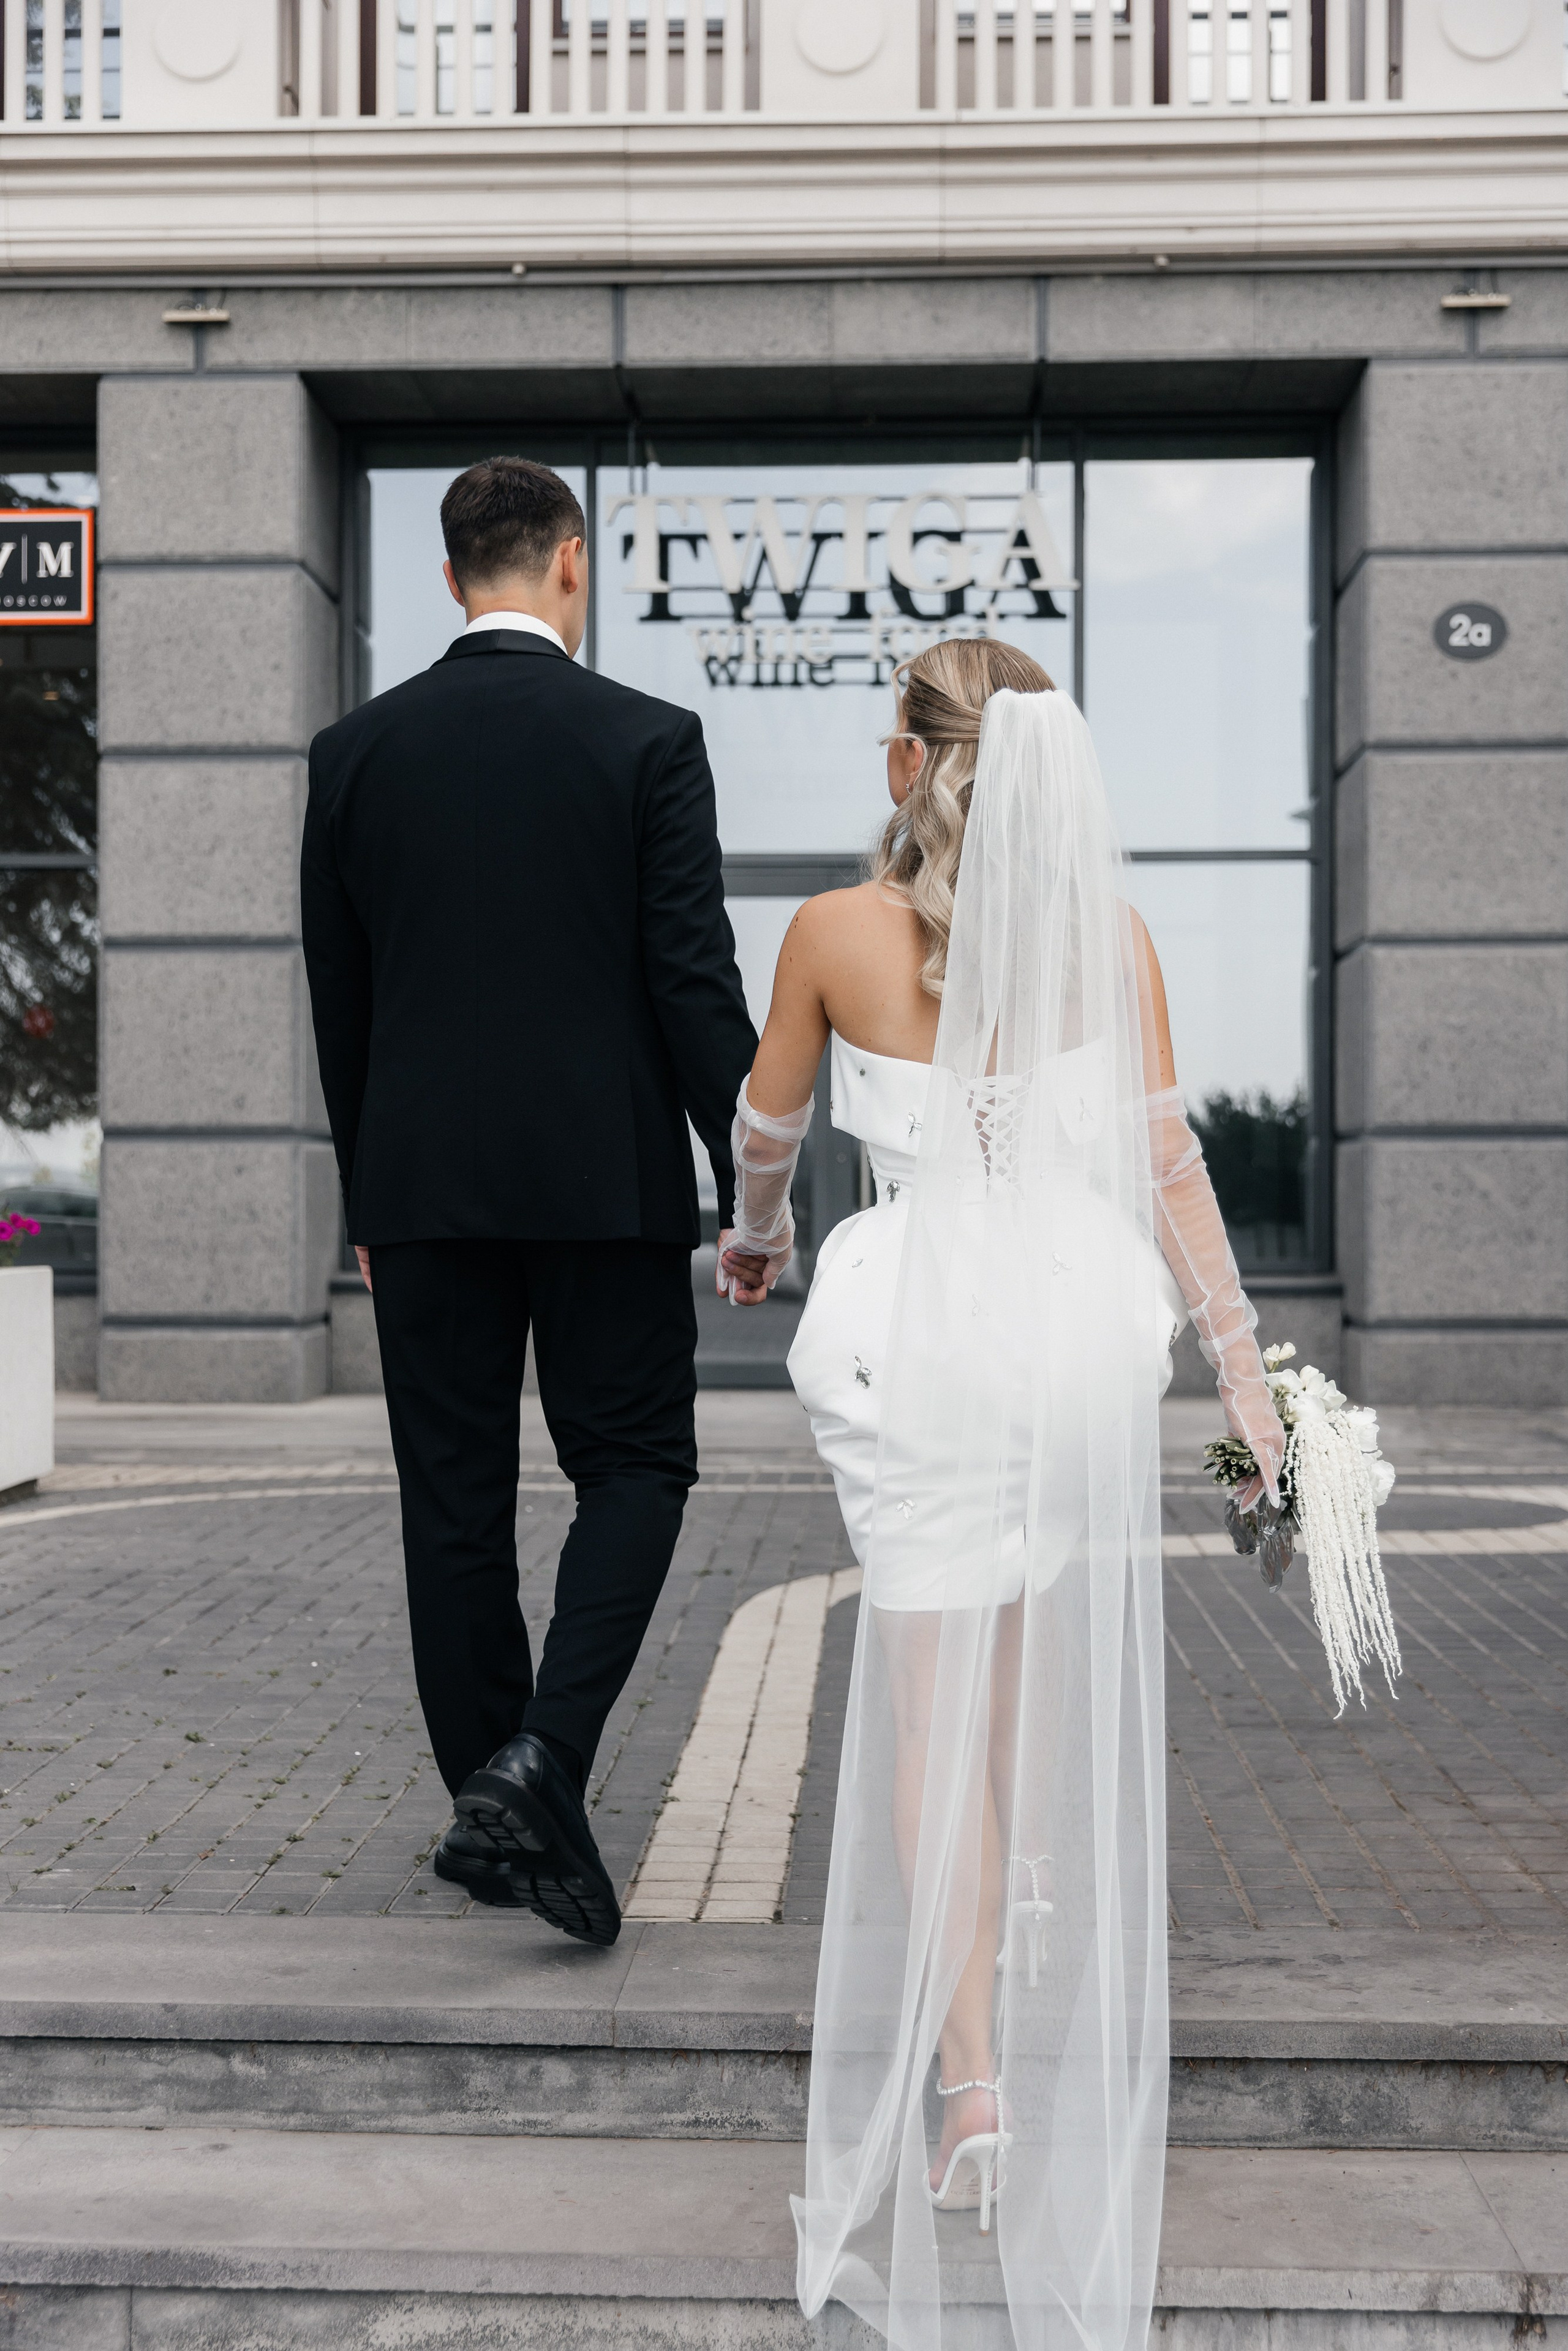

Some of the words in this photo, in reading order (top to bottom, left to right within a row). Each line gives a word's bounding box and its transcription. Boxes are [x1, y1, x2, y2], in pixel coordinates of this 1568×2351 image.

[604, 492, 1081, 594] TWIGA
[687, 605, 835, 665] wine
[1448, 613, 1492, 647] 2a
